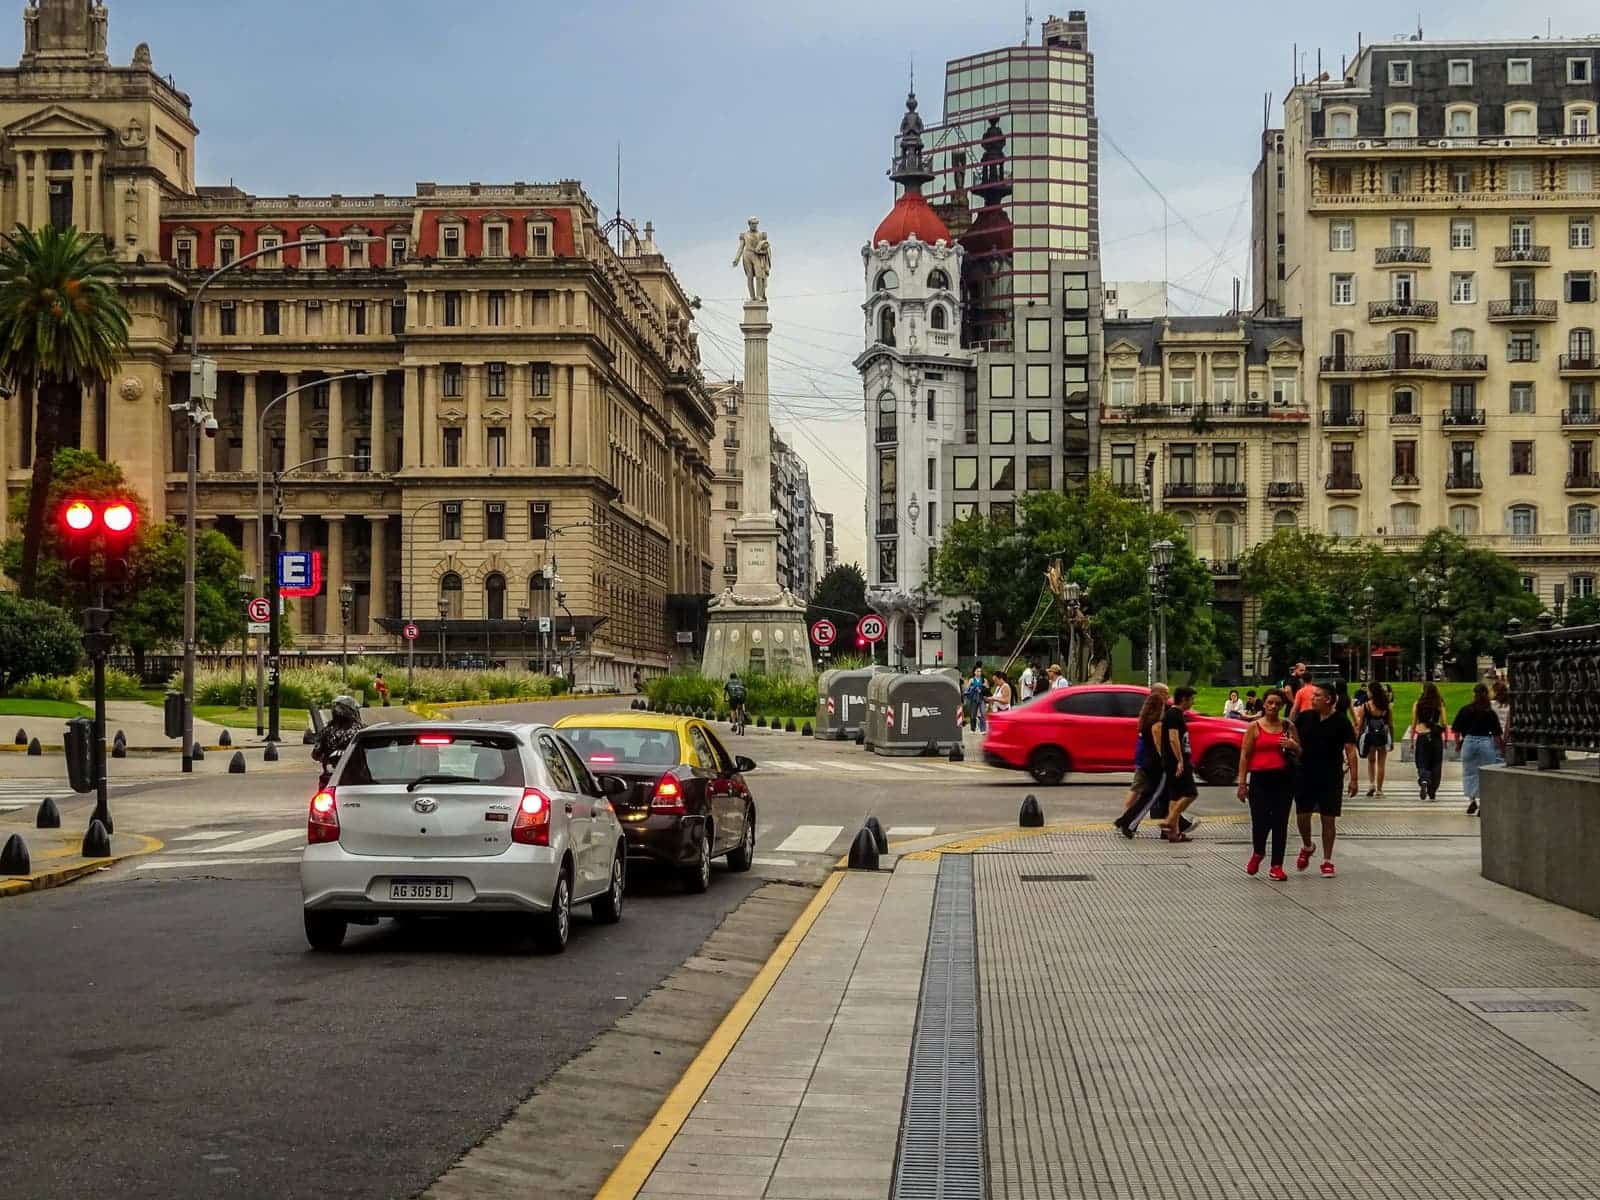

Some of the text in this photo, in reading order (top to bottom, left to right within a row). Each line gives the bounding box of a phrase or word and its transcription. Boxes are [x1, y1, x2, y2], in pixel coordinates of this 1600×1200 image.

[283, 556, 305, 583] E
[819, 626, 829, 639] E
[864, 623, 880, 634] 20
[393, 885, 407, 897] AG
[411, 886, 431, 897] 305
